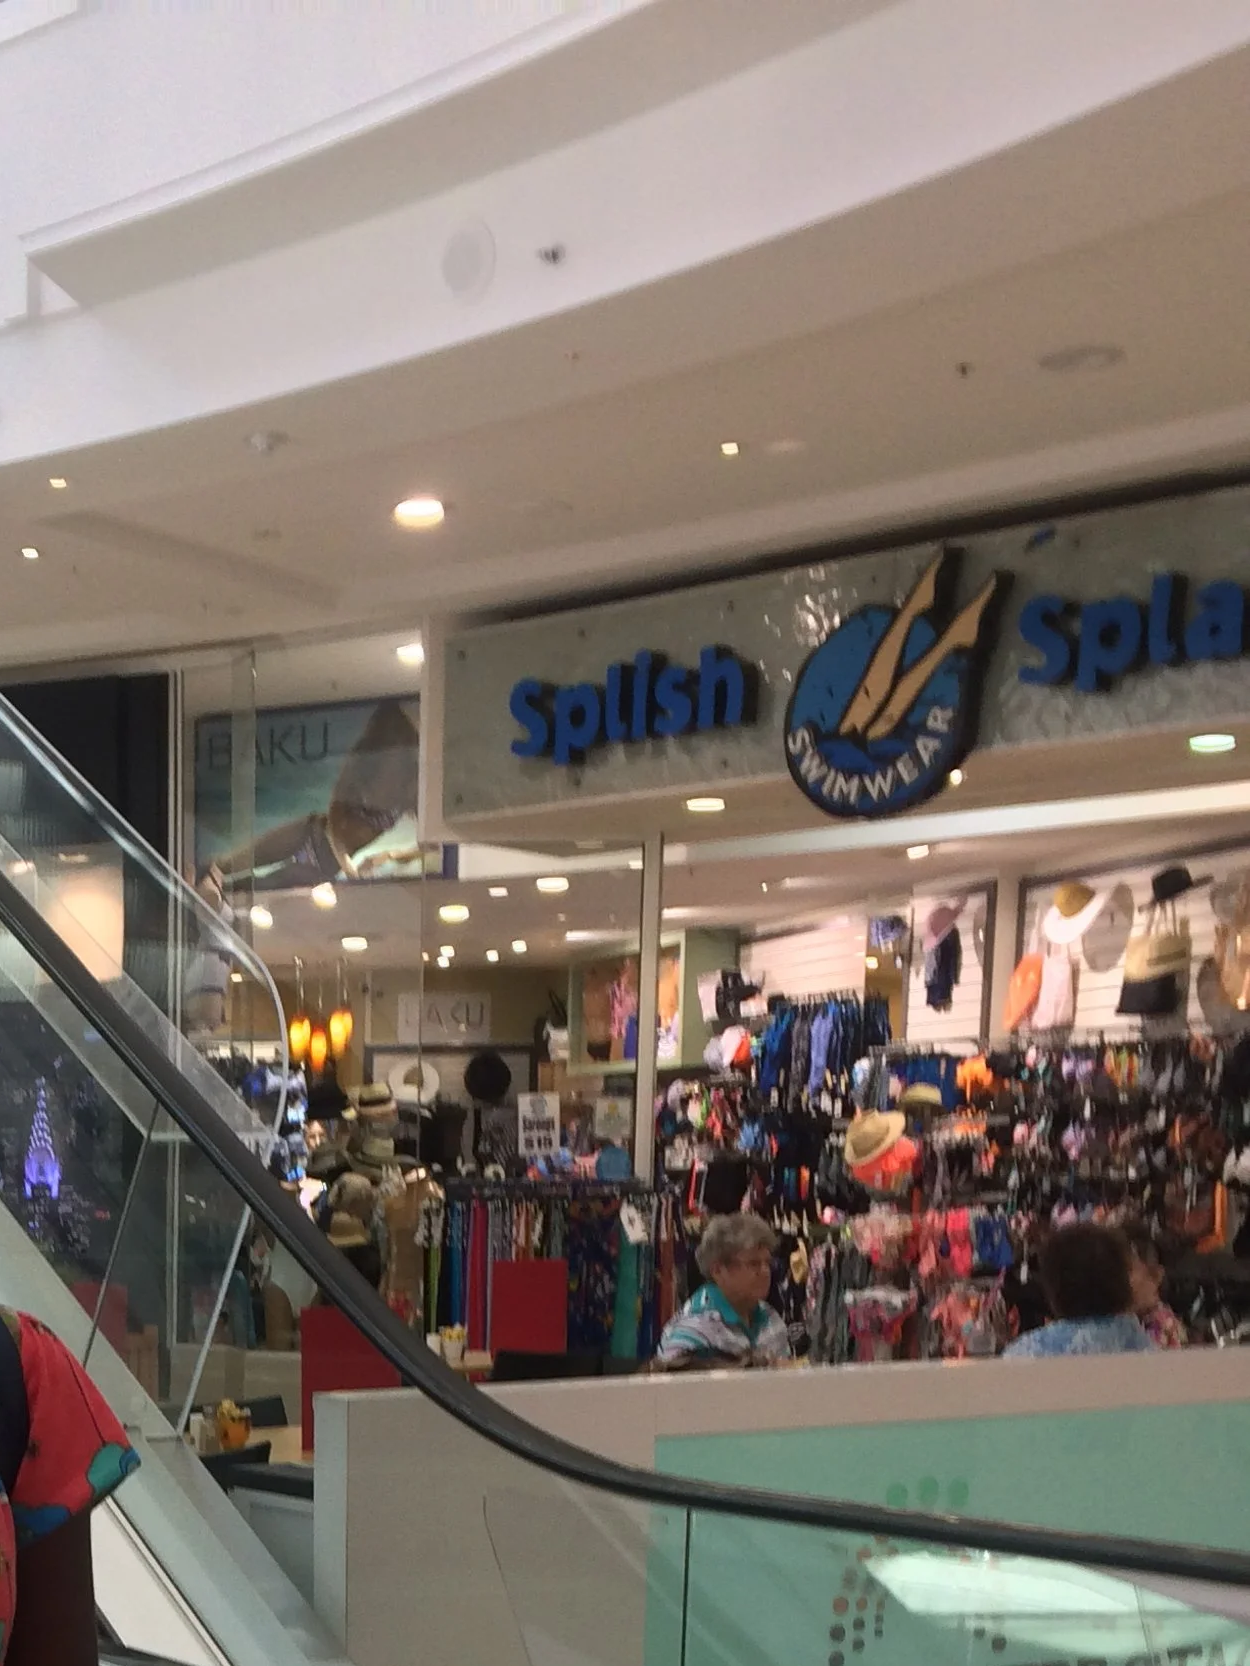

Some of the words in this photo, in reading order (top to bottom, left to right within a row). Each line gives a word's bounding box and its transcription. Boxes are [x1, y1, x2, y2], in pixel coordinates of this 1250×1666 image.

[207, 719, 332, 771] BKU
[509, 645, 746, 765] Splish
[788, 704, 954, 805] SWIMWEAR
